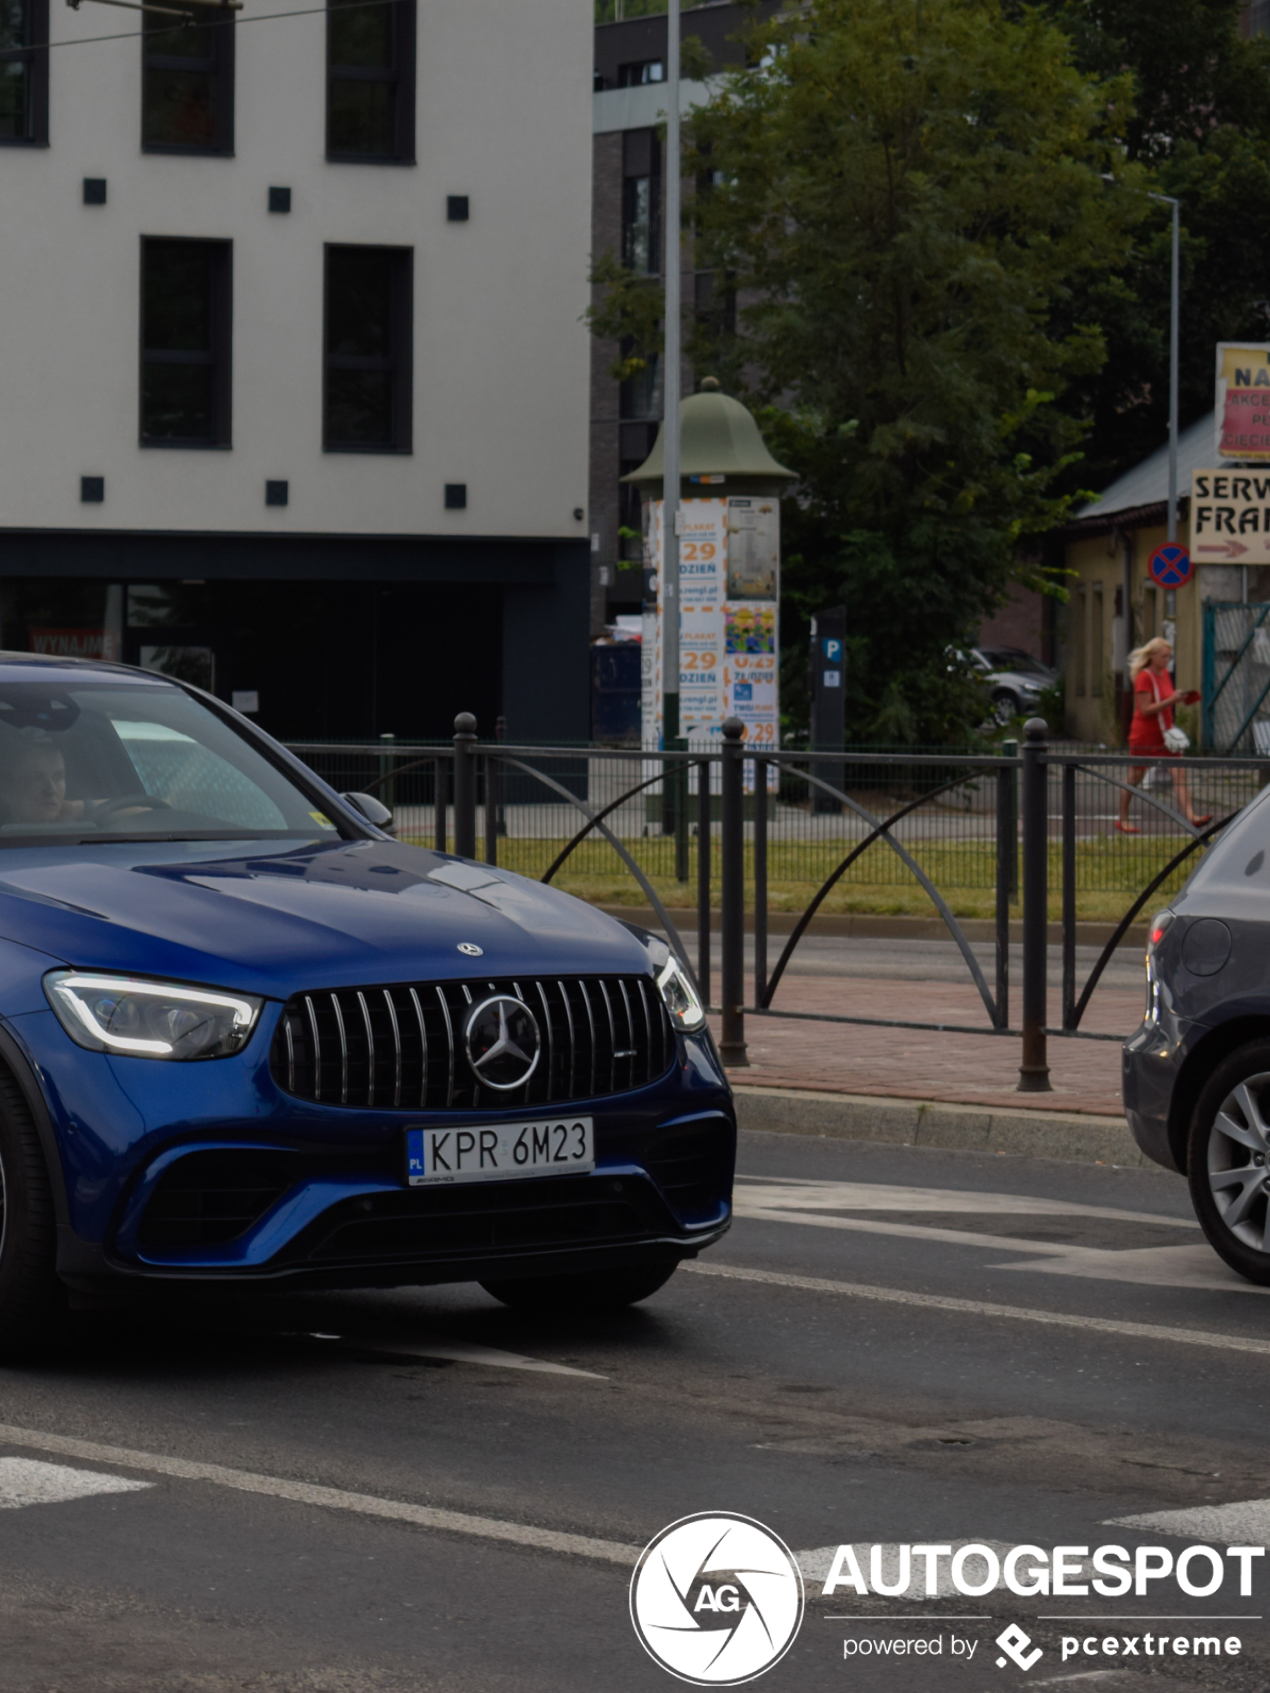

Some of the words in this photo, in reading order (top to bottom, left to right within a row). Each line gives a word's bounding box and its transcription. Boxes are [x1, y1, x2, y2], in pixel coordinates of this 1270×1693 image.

[827, 640, 840, 659] P
[431, 1129, 499, 1172] KPR
[512, 1122, 586, 1166] 6M23
[409, 1158, 423, 1170] PL
